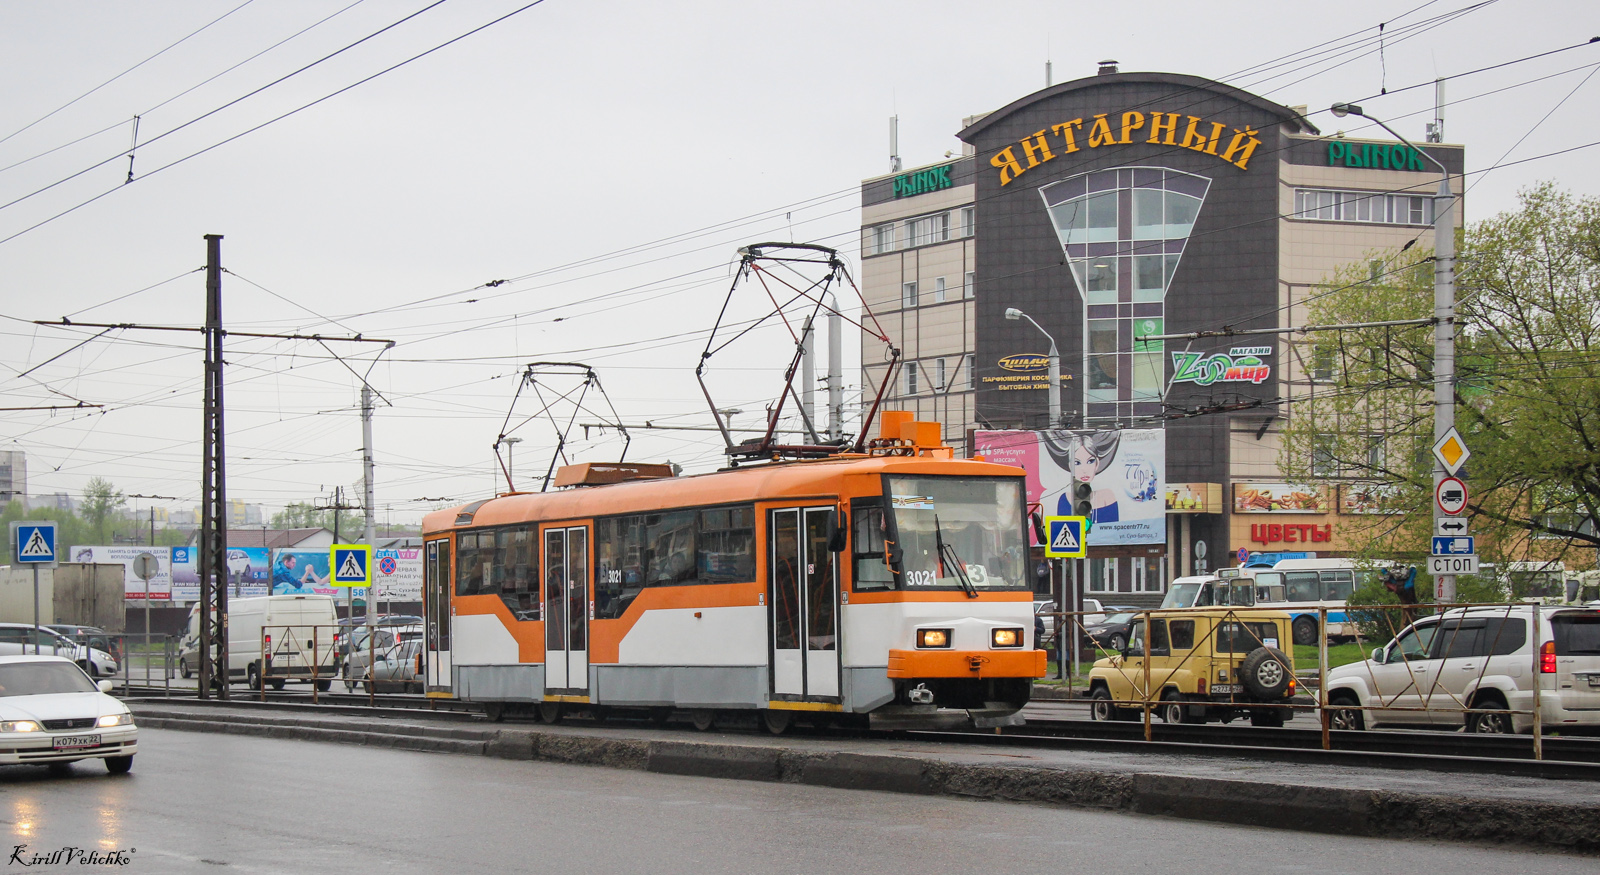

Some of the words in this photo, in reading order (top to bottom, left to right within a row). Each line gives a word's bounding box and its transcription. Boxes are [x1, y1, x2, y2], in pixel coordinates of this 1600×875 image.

[990, 110, 1262, 187] ЯНТАРНЫЙ
[1328, 140, 1426, 170] РЫНОК
[893, 164, 953, 199] РЫНОК
[1230, 346, 1271, 355] МАГАЗИН
[982, 375, 1030, 383] ПАРФЮМЕРИЯ
[993, 448, 1026, 457] SPA-услуги
[1251, 523, 1332, 546] ЦВЕТЫ
[1434, 559, 1471, 572] СТОП
[608, 569, 622, 584] 3021
[906, 570, 937, 586] 3021
[968, 565, 985, 583] 3
